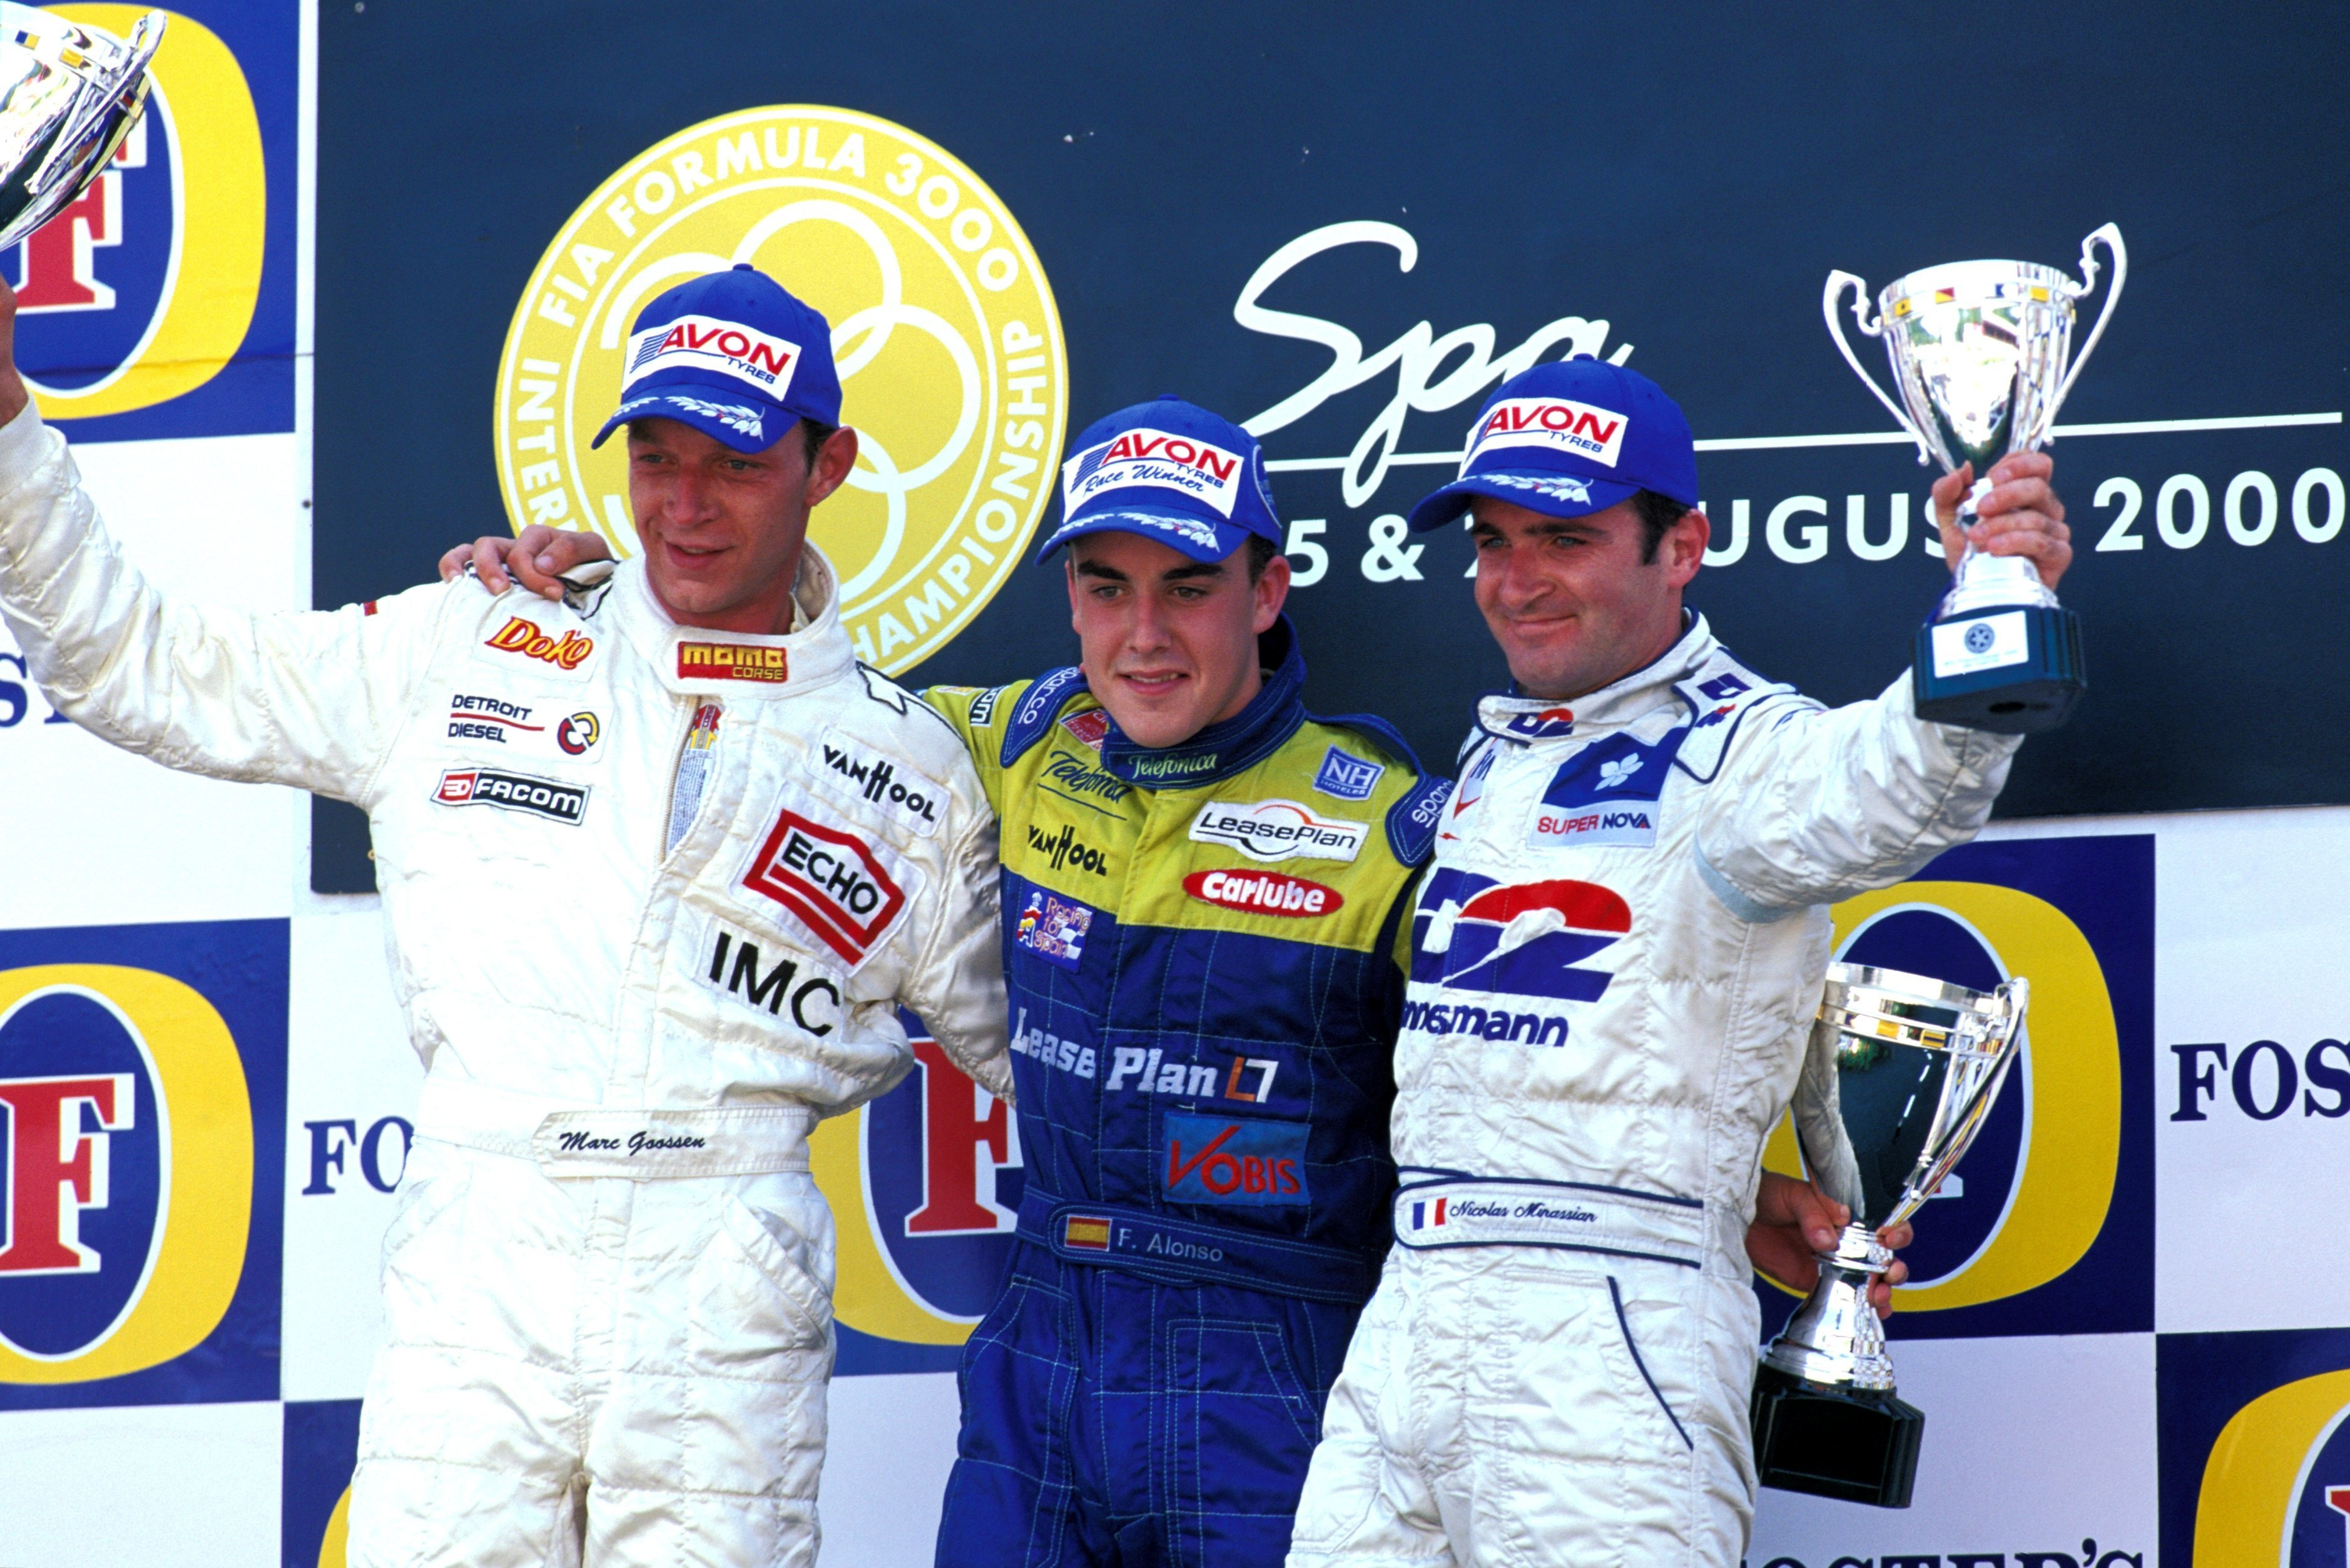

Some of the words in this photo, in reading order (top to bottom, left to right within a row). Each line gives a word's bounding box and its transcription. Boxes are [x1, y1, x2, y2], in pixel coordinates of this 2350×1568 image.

[539, 242, 614, 327] FIA
[606, 126, 867, 237] FORMULA
[885, 153, 1019, 291] 3000
[658, 323, 791, 376] AVON
[728, 357, 776, 385] TYRES
[1483, 405, 1619, 444] AVON
[1101, 433, 1237, 481] AVON
[1549, 430, 1603, 453] TYRES
[1083, 470, 1124, 497] Race
[1132, 465, 1204, 492] Winner
[1176, 463, 1224, 489] TYRES
[1360, 514, 1426, 583] &
[2092, 467, 2347, 552] 2000
[732, 667, 784, 680] CORSE
[451, 695, 532, 720] DETROIT
[448, 723, 507, 743] DIESEL
[1321, 780, 1366, 796] HOTELES
[1325, 756, 1374, 787] NH
[474, 778, 582, 815] FACOM
[1199, 812, 1357, 849] LeasePlan
[1537, 814, 1600, 835] SUPER
[1602, 812, 1652, 830] NOVA
[781, 832, 879, 915] ECHO
[1201, 872, 1326, 912] Carlube
[1043, 917, 1062, 936] for
[1045, 896, 1091, 935] Racing
[1033, 930, 1069, 960] Spain
[708, 932, 841, 1038] IMC
[1010, 1007, 1096, 1079] Lease
[1106, 1046, 1218, 1097] Plan
[559, 1131, 621, 1151] Marc
[627, 1130, 706, 1157] Goossen
[1168, 1125, 1301, 1196] VOBIS
[1449, 1200, 1509, 1218] Nicolas
[1118, 1228, 1137, 1250] F.
[1147, 1233, 1224, 1262] Alonso
